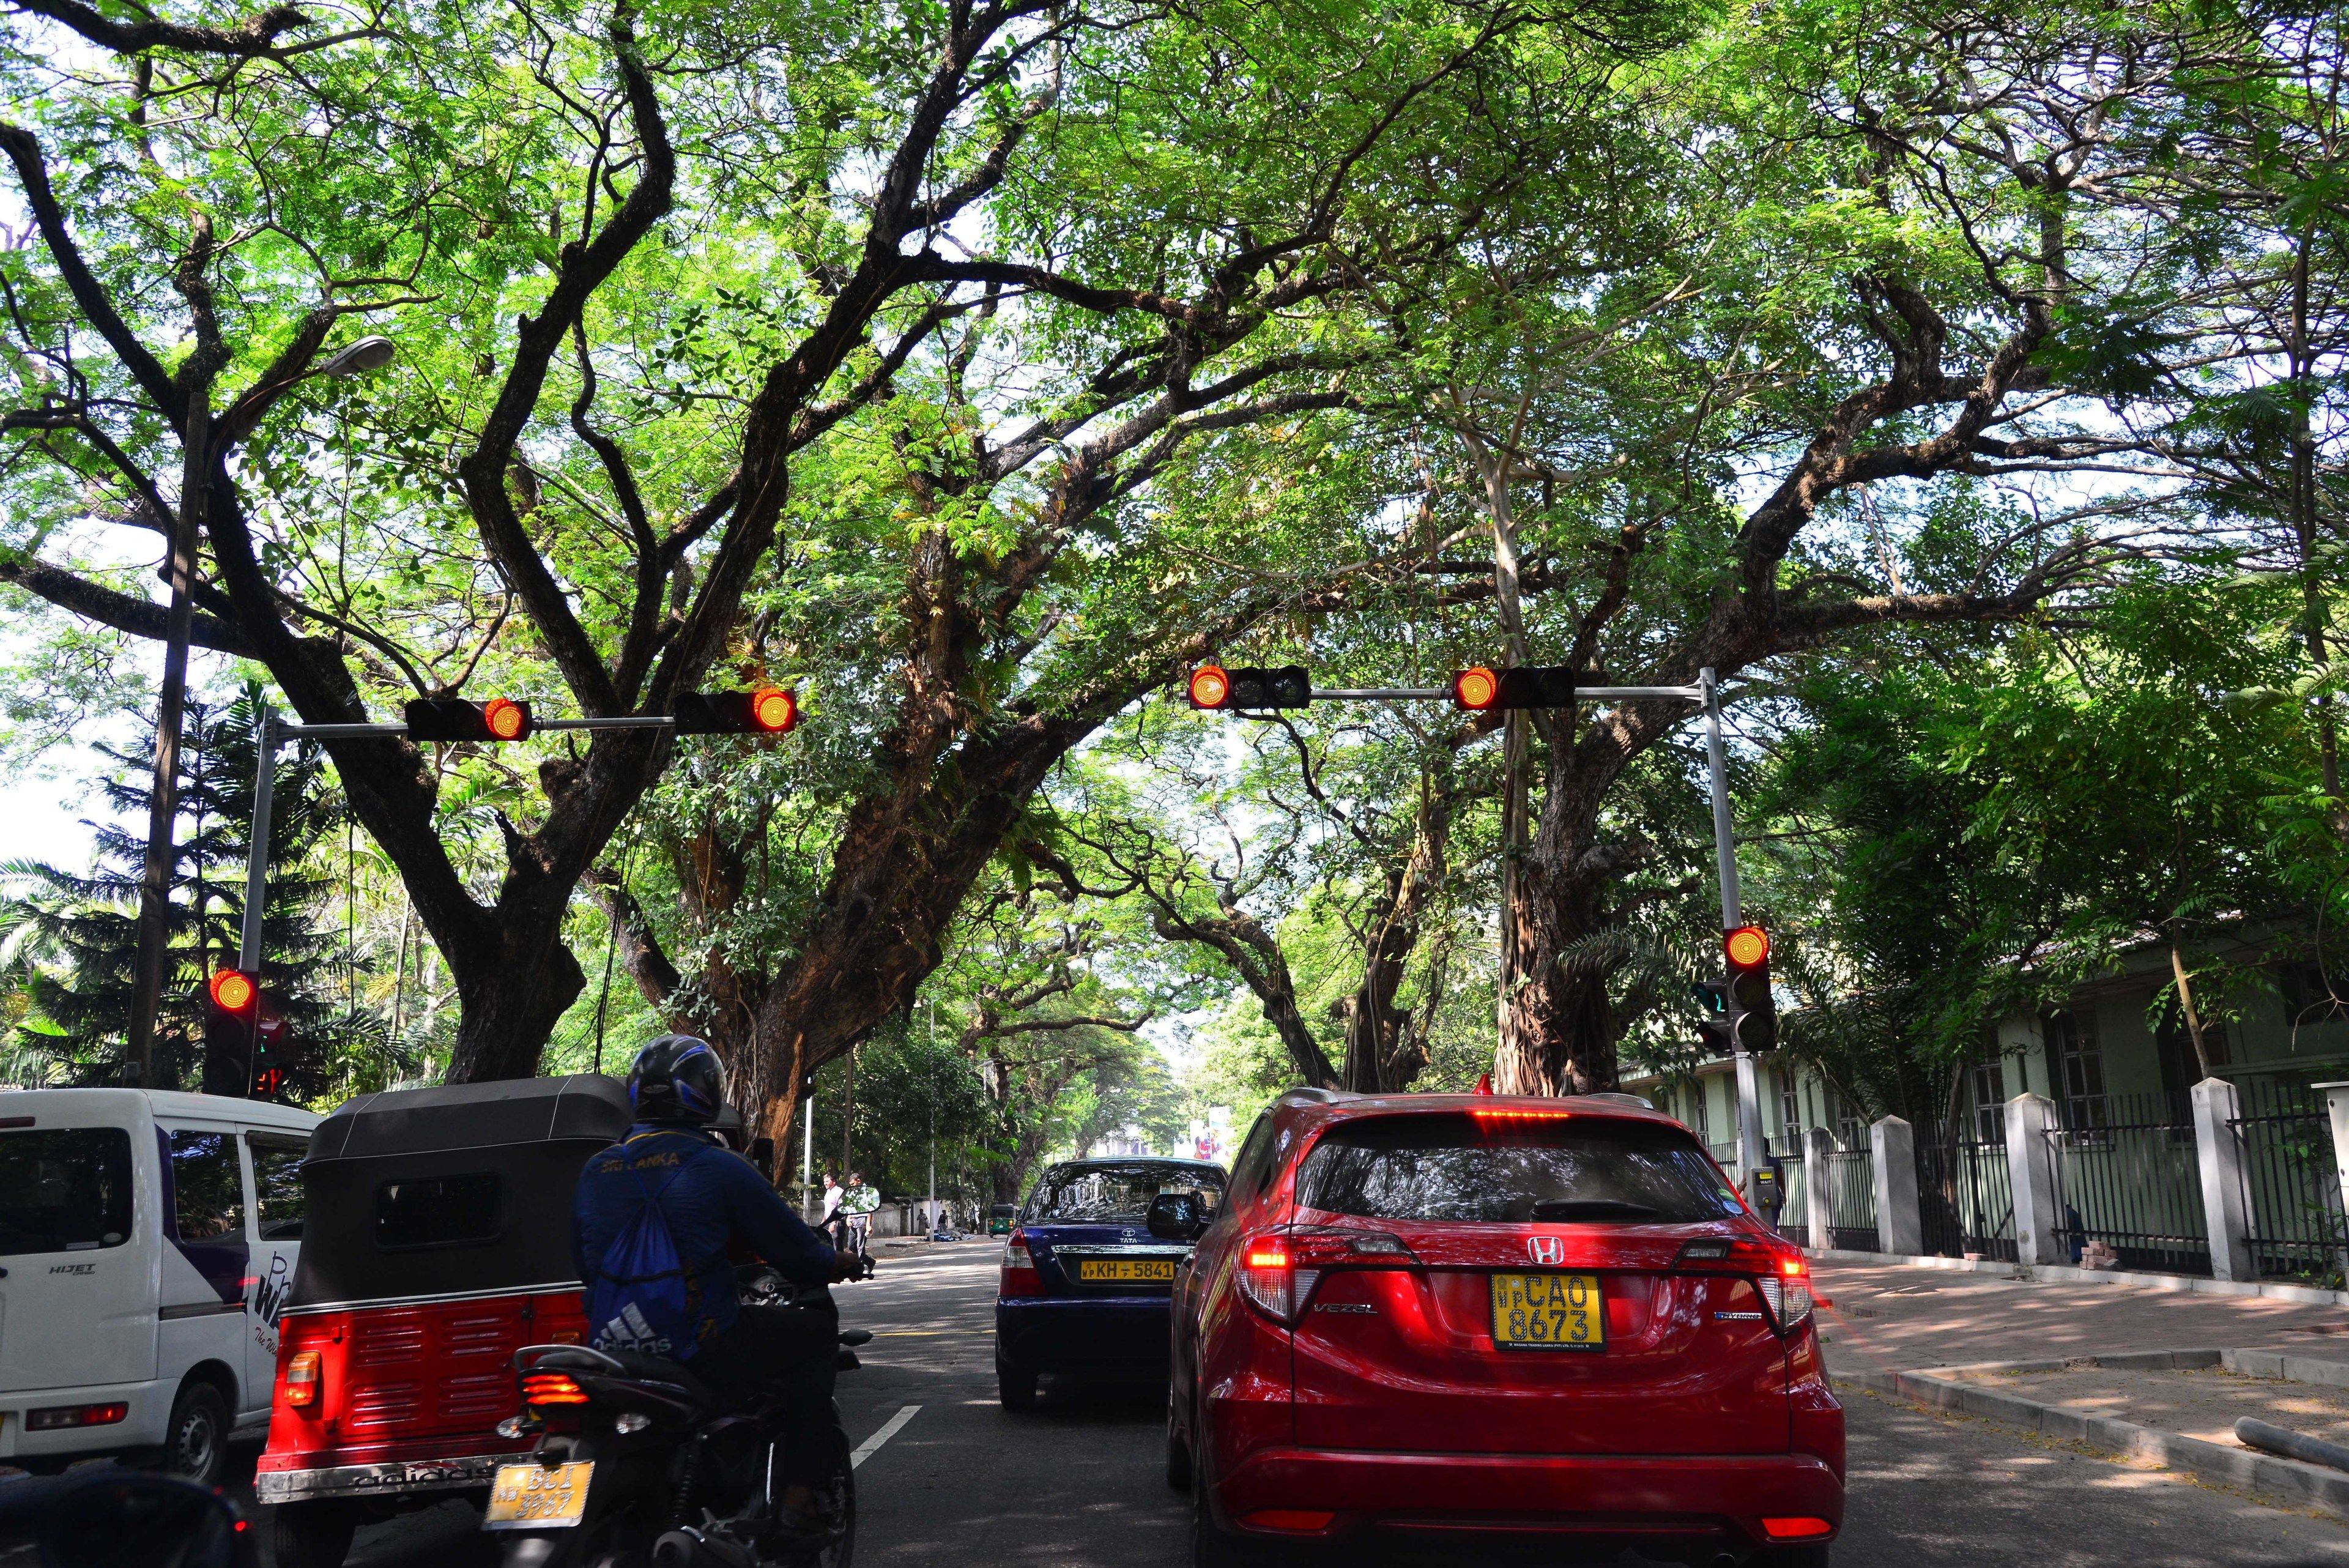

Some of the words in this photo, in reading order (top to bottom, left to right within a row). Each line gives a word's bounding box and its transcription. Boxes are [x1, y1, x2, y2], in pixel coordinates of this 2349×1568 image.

[49, 1263, 97, 1274] HIJET
[1134, 1262, 1172, 1278] 5841
[1524, 1276, 1587, 1308] CAO
[1314, 1303, 1378, 1313] VEZEL
[1508, 1309, 1588, 1340] 8673
[593, 1338, 672, 1353] adidas
[355, 1466, 493, 1487] adidas
[527, 1465, 577, 1490] BCI
